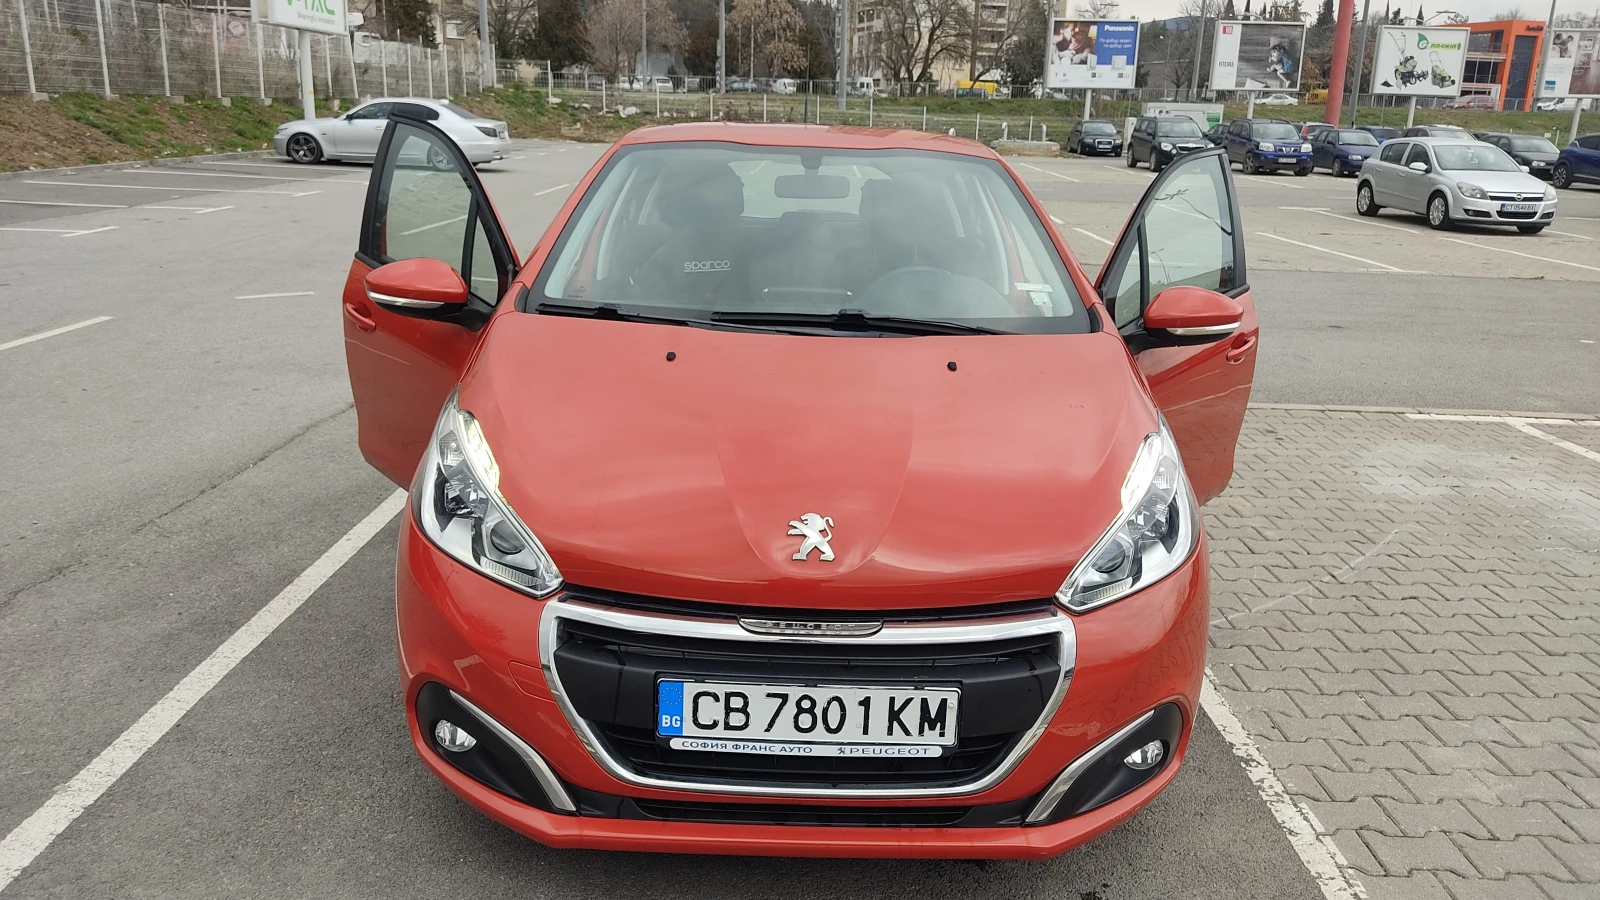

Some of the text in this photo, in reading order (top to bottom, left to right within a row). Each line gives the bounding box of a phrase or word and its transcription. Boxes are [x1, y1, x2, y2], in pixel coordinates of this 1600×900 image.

[684, 260, 731, 273] sparco
[691, 690, 949, 738] CB 7801 KM
[661, 714, 681, 728] BG
[681, 741, 812, 754] СОФИЯ ФРАНС АУТО
[849, 747, 931, 756] PEUGEOT
